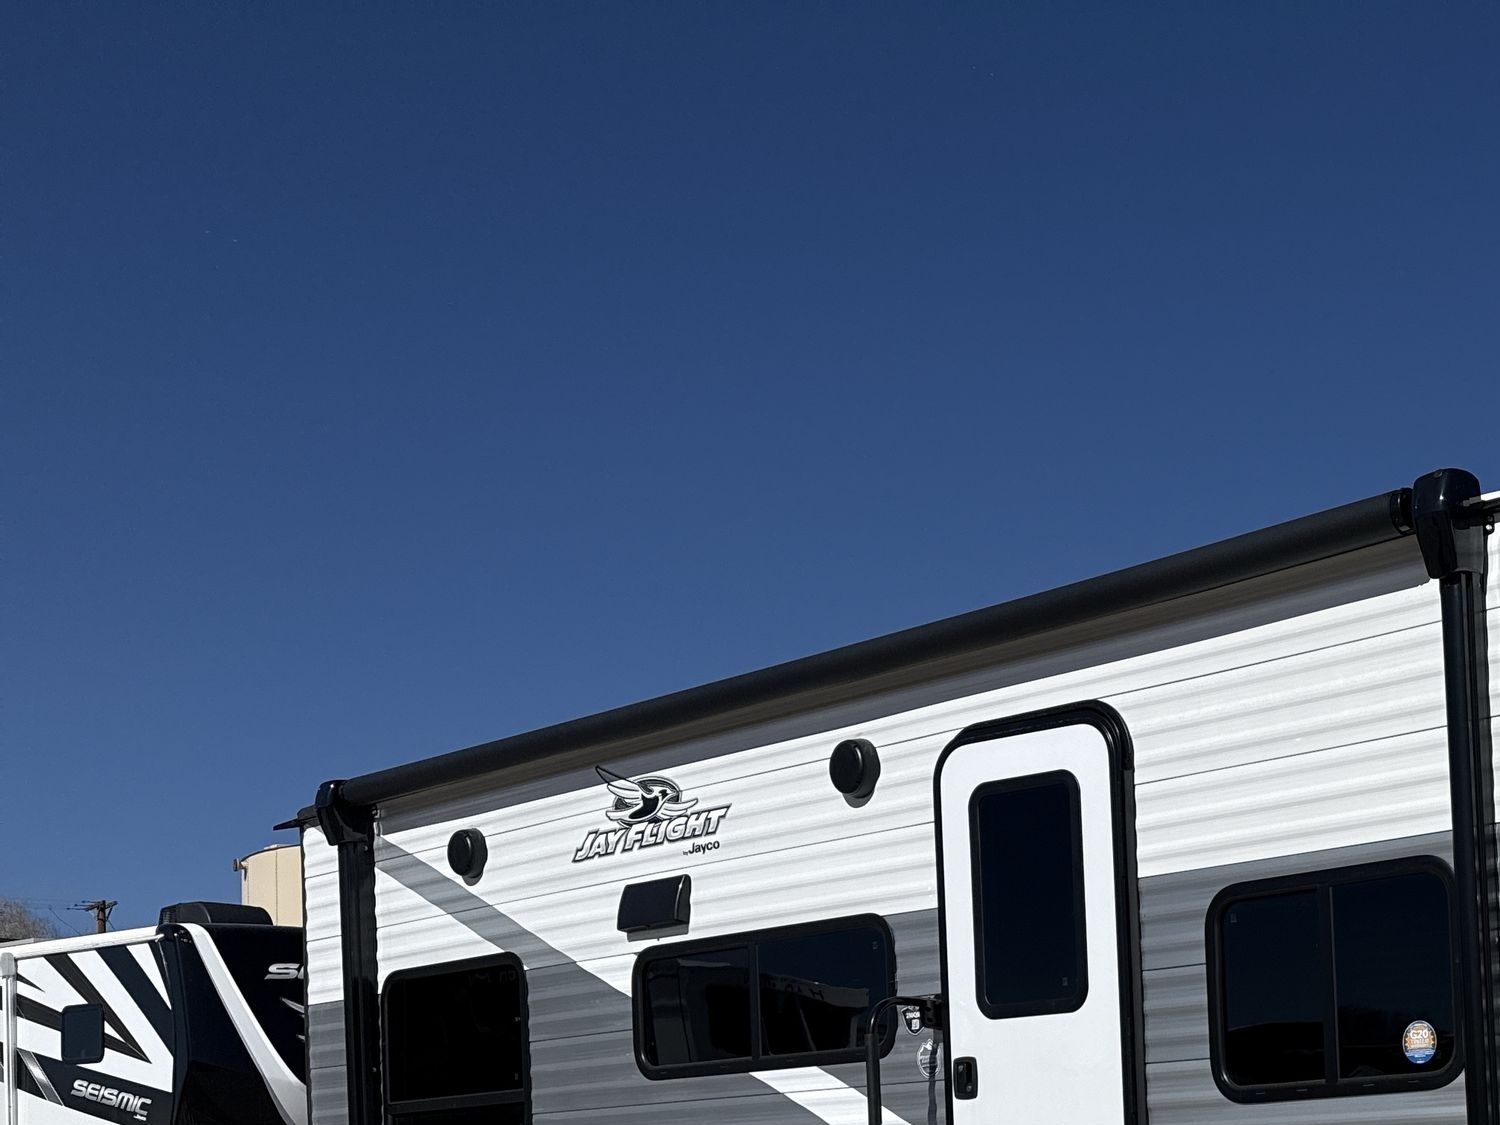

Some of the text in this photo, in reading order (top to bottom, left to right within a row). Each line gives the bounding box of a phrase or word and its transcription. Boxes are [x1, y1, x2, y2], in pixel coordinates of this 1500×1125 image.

[572, 803, 732, 863] JAY FLIGHT
[689, 841, 720, 854] Jayco
[70, 1079, 152, 1116] SEISMIC
